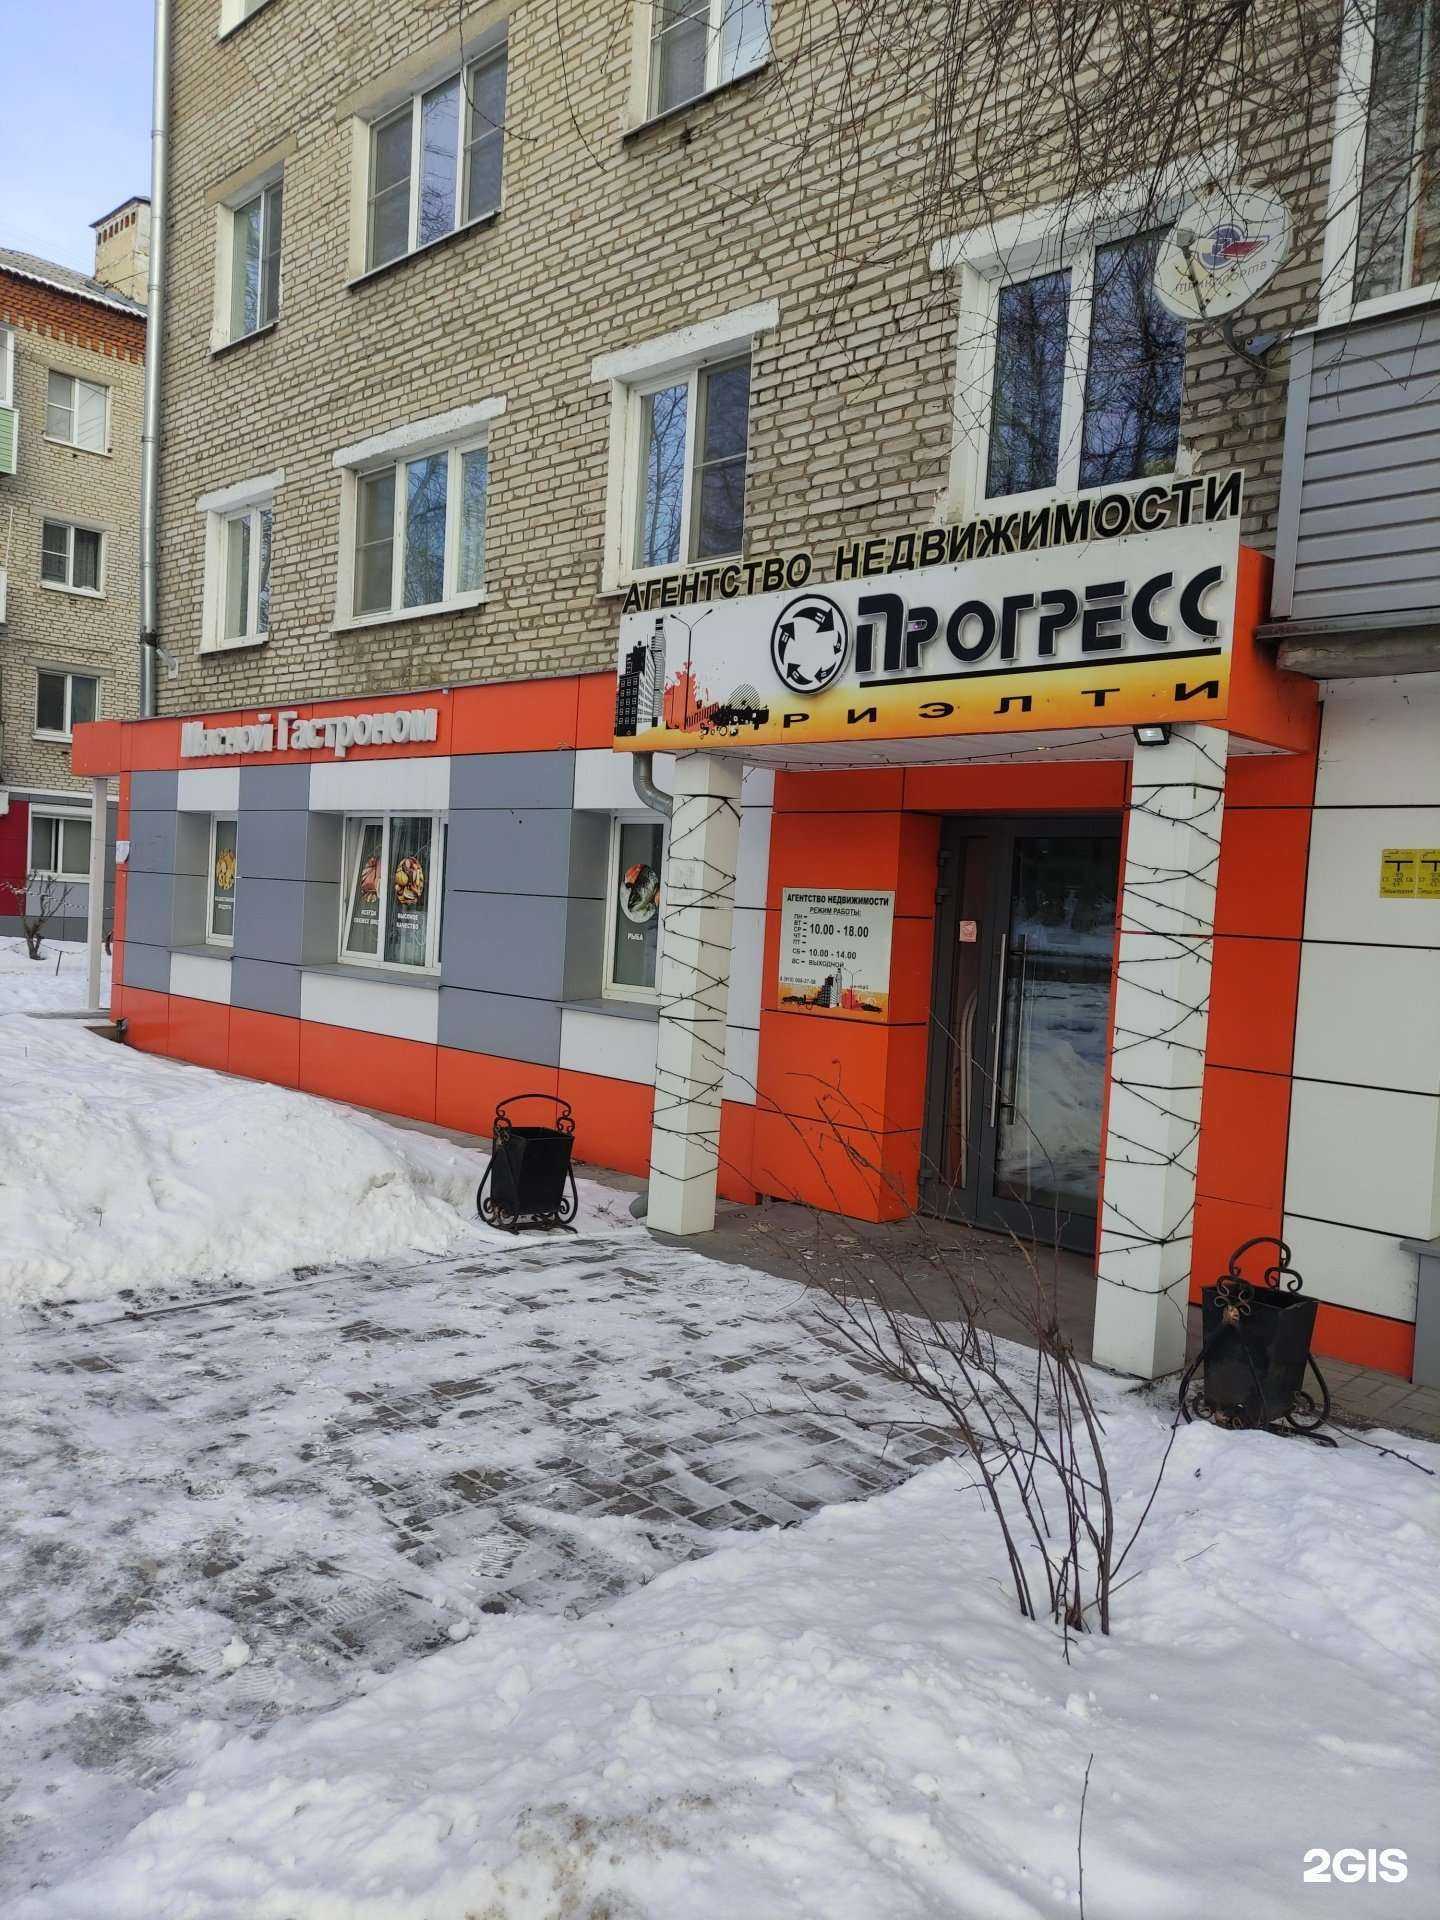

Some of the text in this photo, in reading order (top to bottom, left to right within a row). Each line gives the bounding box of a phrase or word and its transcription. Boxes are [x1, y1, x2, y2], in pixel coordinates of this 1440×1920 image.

[621, 470, 1245, 614] АГЕНТСТВО НЕДВИЖИМОСТИ
[855, 564, 1225, 675] ПРОГРЕСС
[277, 708, 439, 758] Гастроном
[787, 894, 889, 906] АГЕНТСТВО НЕДВИЖИМОСТИ
[809, 906, 832, 915] РЕЖИМ
[809, 923, 834, 935] 10.00
[843, 926, 869, 938] 18.00
[809, 948, 829, 958] 10.00
[836, 950, 857, 960] 14.00
[808, 959, 845, 968] ВЫХОДНОЙ
